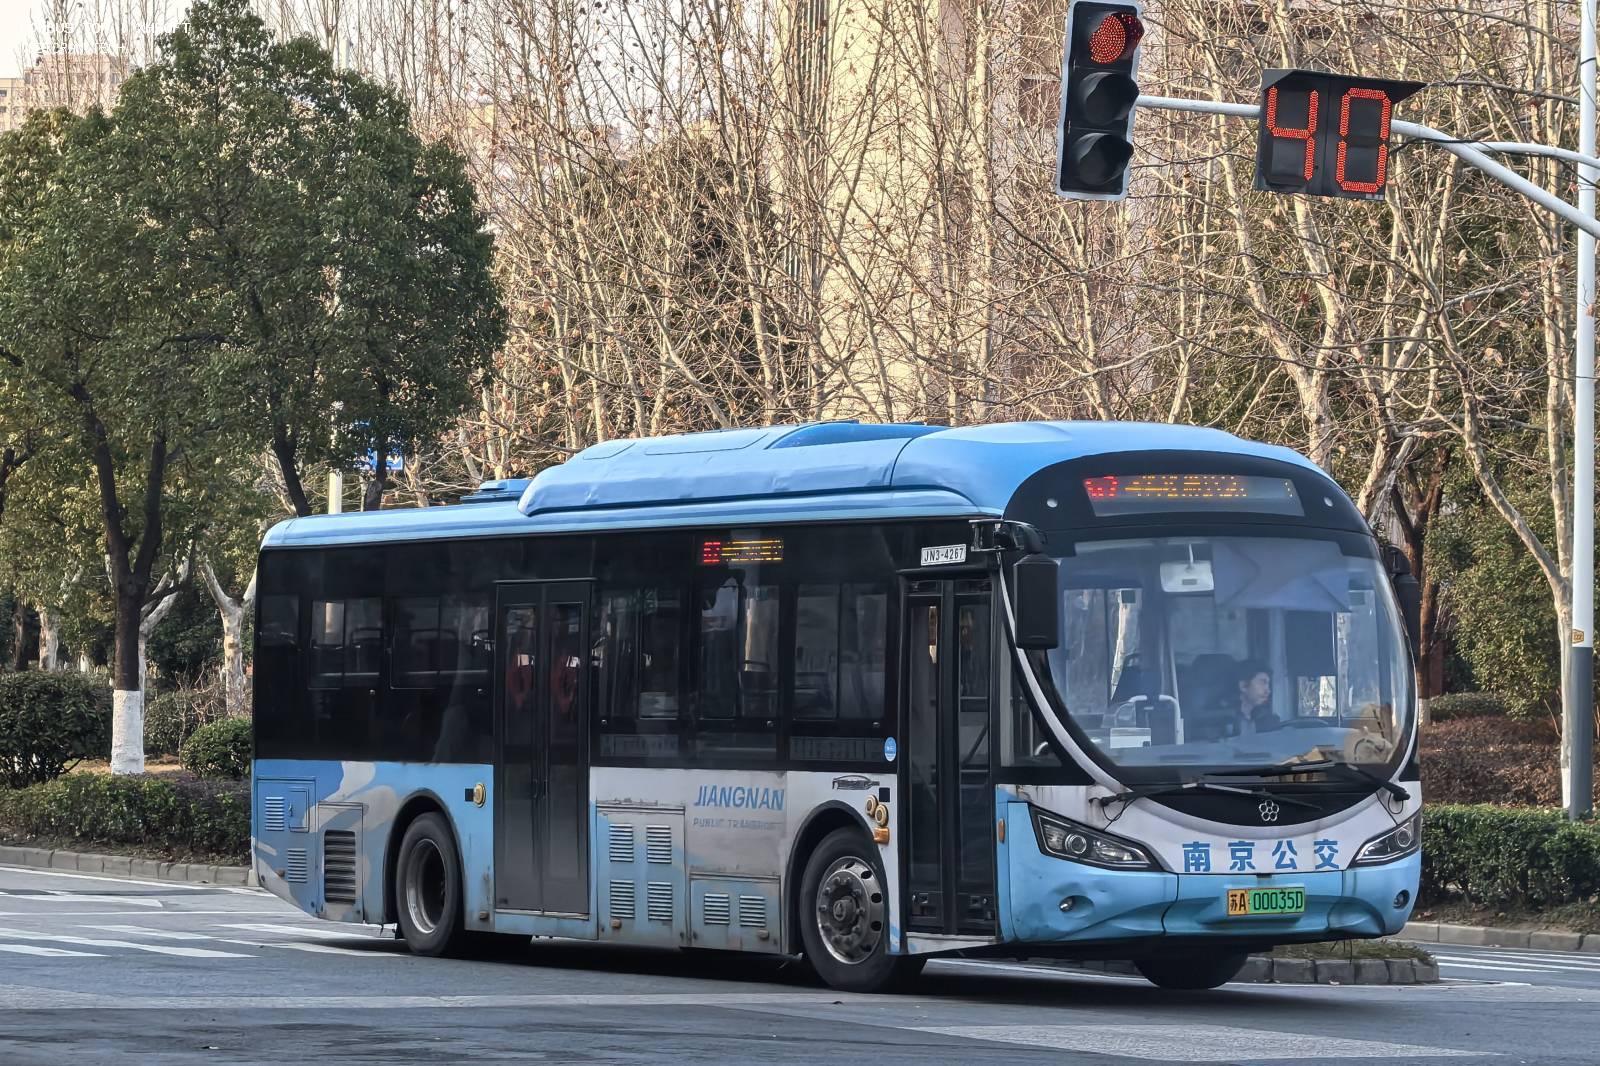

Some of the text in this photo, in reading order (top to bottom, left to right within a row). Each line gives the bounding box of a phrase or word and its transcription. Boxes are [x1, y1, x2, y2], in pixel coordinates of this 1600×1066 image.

[1266, 86, 1392, 194] 40
[924, 547, 964, 562] JN3-4267
[693, 785, 785, 811] JIANGNAN
[1182, 839, 1340, 872] 南京公交
